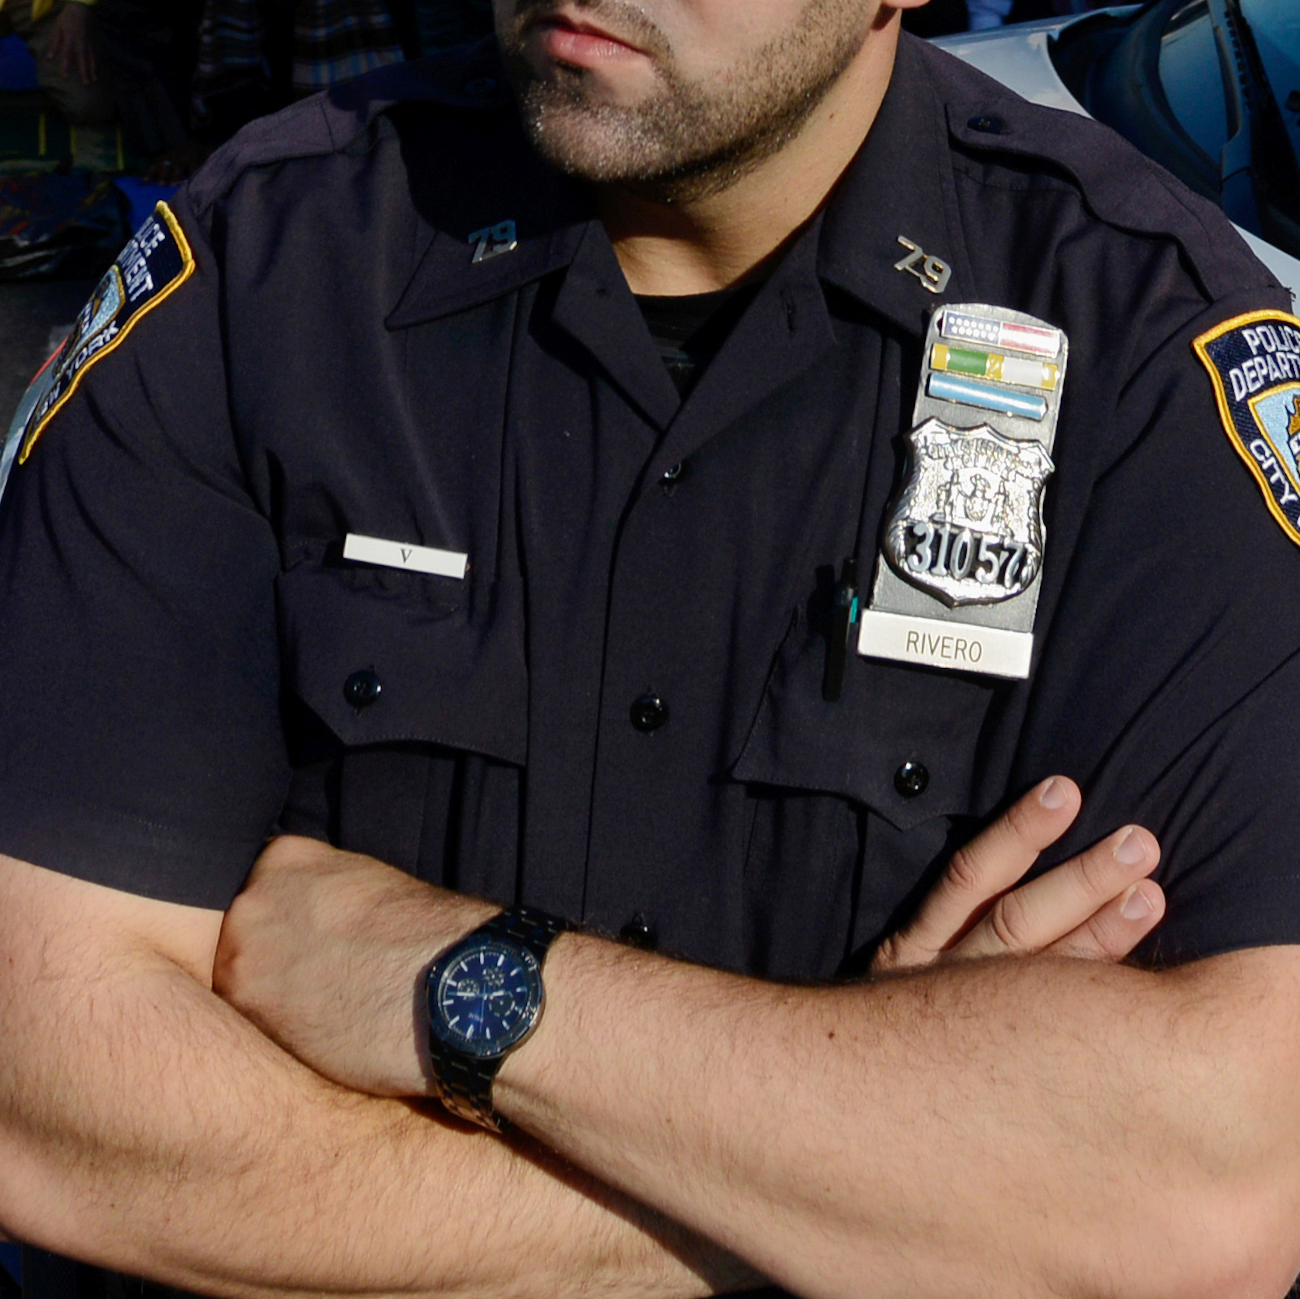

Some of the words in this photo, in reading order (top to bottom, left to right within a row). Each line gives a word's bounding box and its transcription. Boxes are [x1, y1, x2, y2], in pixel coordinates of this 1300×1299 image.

[468, 219, 517, 264] 79
[894, 235, 952, 293] 79
[65, 320, 120, 381] YORK
[1249, 438, 1299, 505] CITY
[907, 522, 1024, 589] 31057
[906, 630, 983, 663] RIVERO
